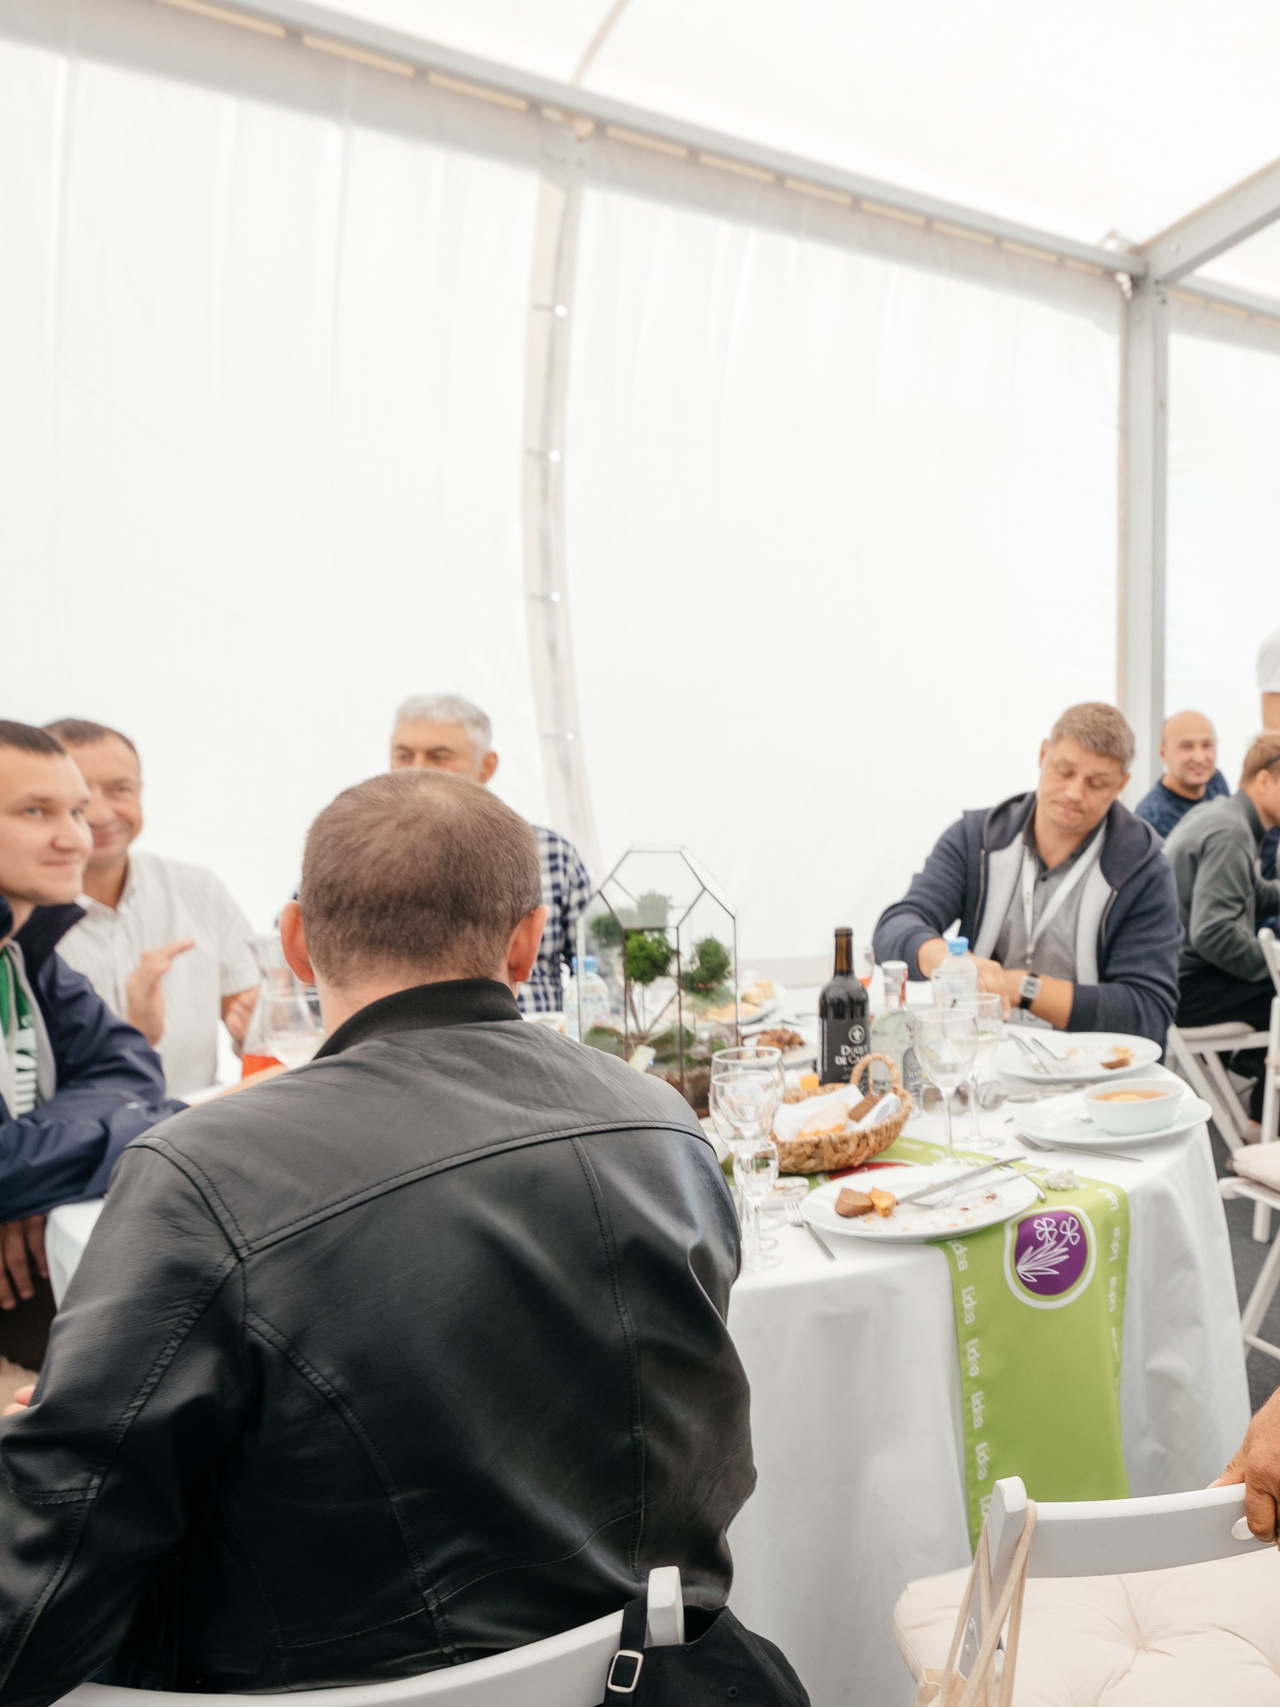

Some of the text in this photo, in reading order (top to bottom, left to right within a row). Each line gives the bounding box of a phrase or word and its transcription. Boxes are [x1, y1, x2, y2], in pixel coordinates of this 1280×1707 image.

[962, 1285, 977, 1324] Lidea
[966, 1338, 980, 1377] Lidea
[970, 1390, 985, 1429] Lidea
[975, 1441, 990, 1481] Lidea
